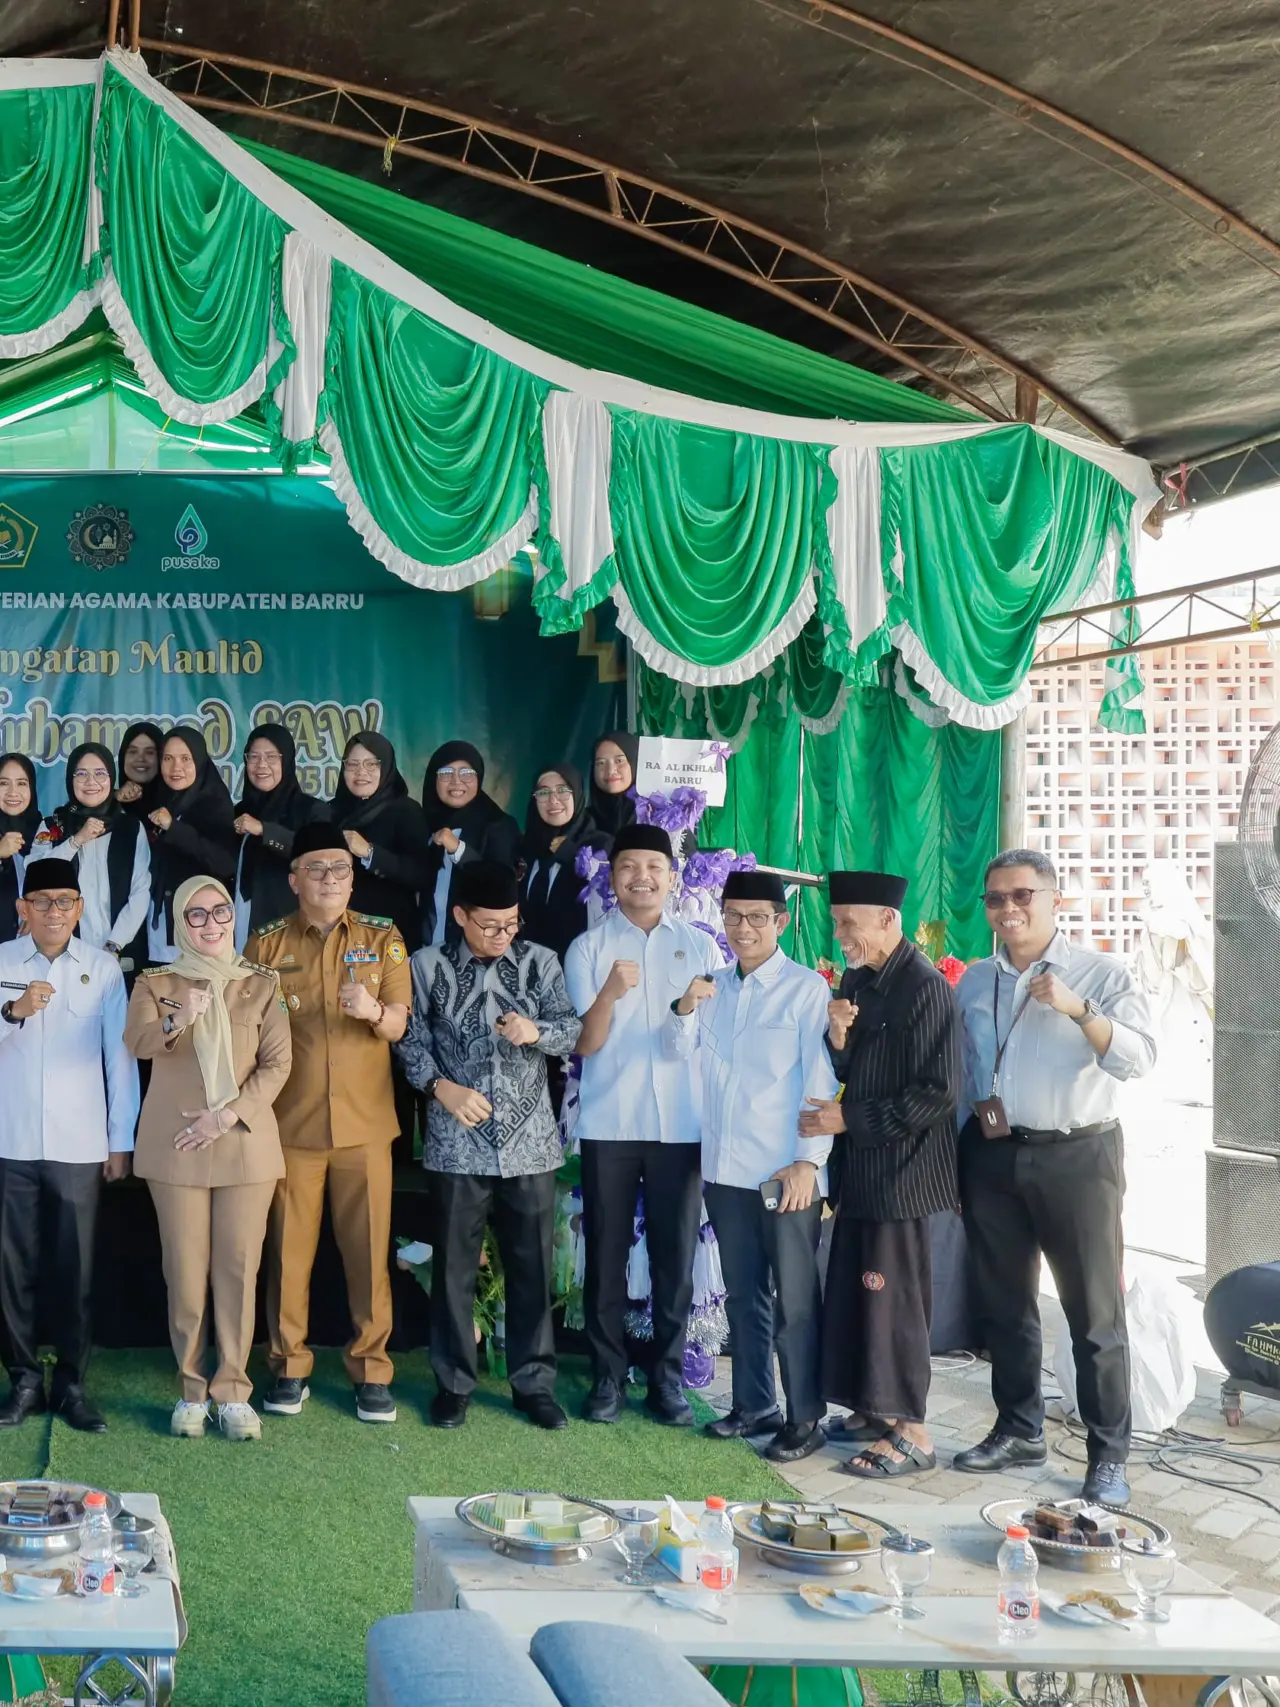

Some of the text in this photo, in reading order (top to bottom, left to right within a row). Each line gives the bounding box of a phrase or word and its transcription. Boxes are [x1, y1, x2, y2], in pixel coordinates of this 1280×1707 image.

[161, 554, 220, 571] pusaka
[69, 592, 152, 609] AGAMA
[156, 593, 287, 610] KABUPATEN
[291, 593, 364, 610] BARRU
[128, 634, 264, 675] Maulid
[645, 761, 661, 770] RA
[666, 763, 680, 771] AL
[664, 776, 702, 785] BARRU
[1011, 1603, 1029, 1616] Cleo
